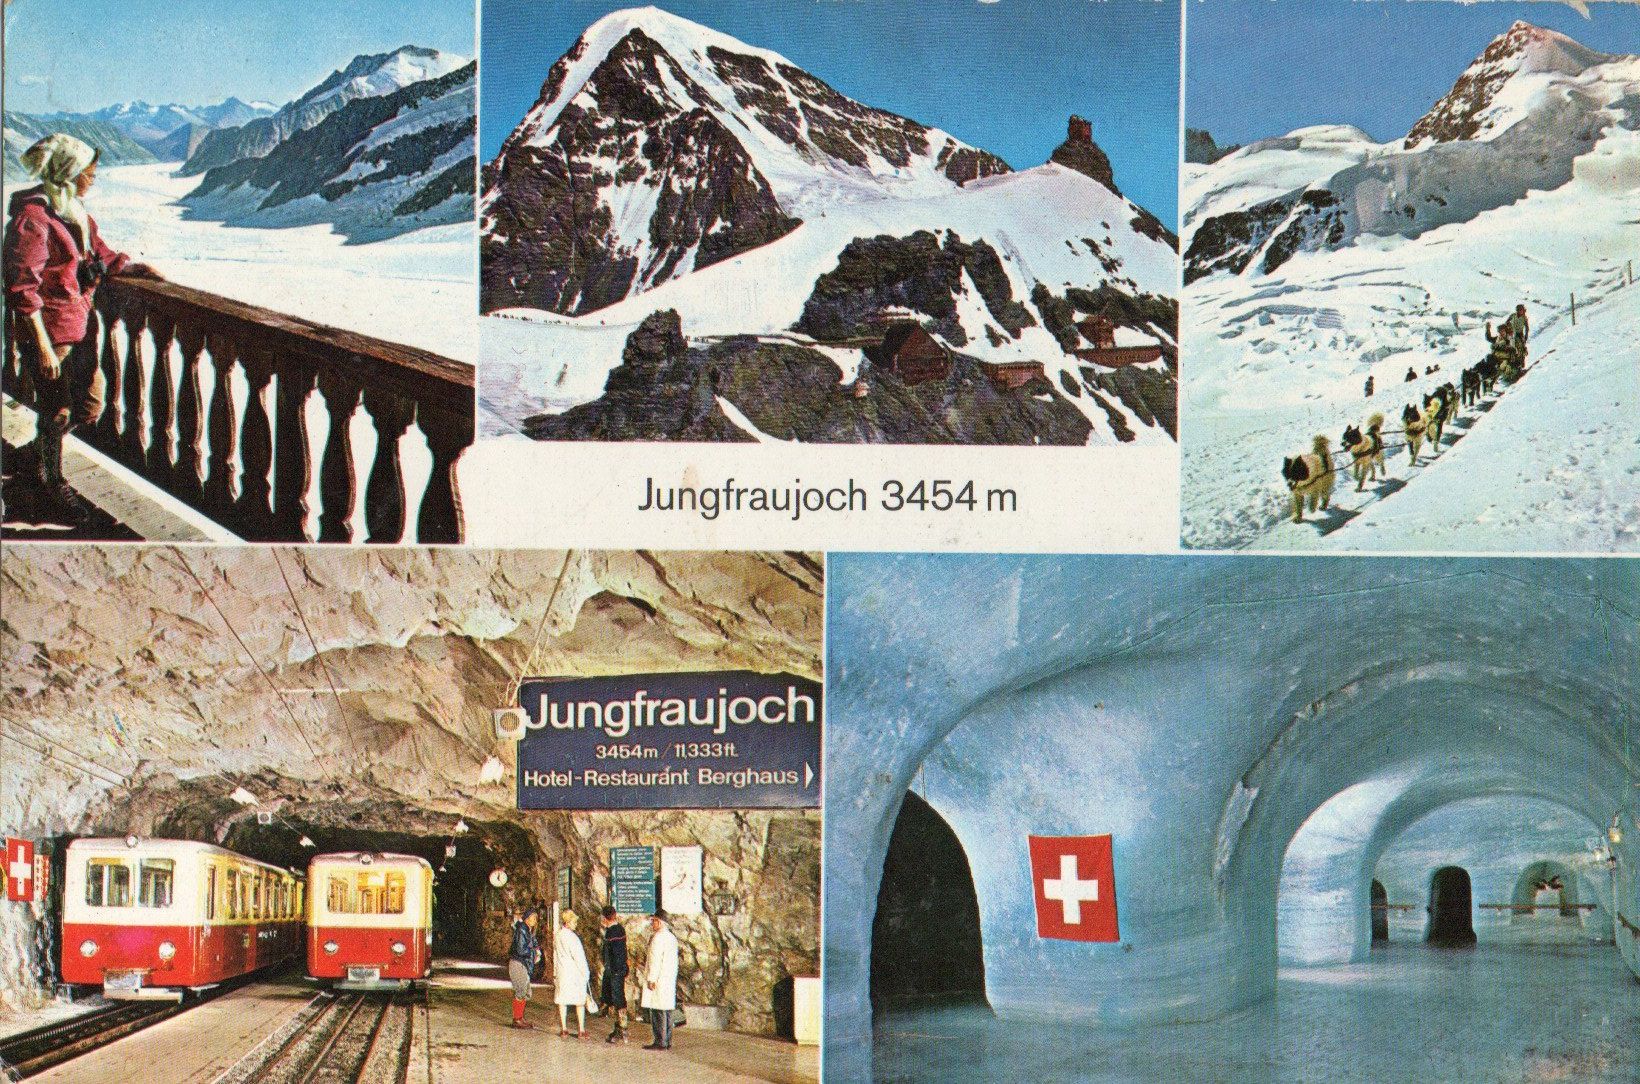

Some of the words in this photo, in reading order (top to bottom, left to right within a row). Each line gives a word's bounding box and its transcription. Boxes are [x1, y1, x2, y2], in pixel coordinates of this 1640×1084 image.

[525, 685, 815, 738] Jungfraujoch
[595, 743, 659, 760] 3454m
[698, 767, 800, 789] Berghaus
